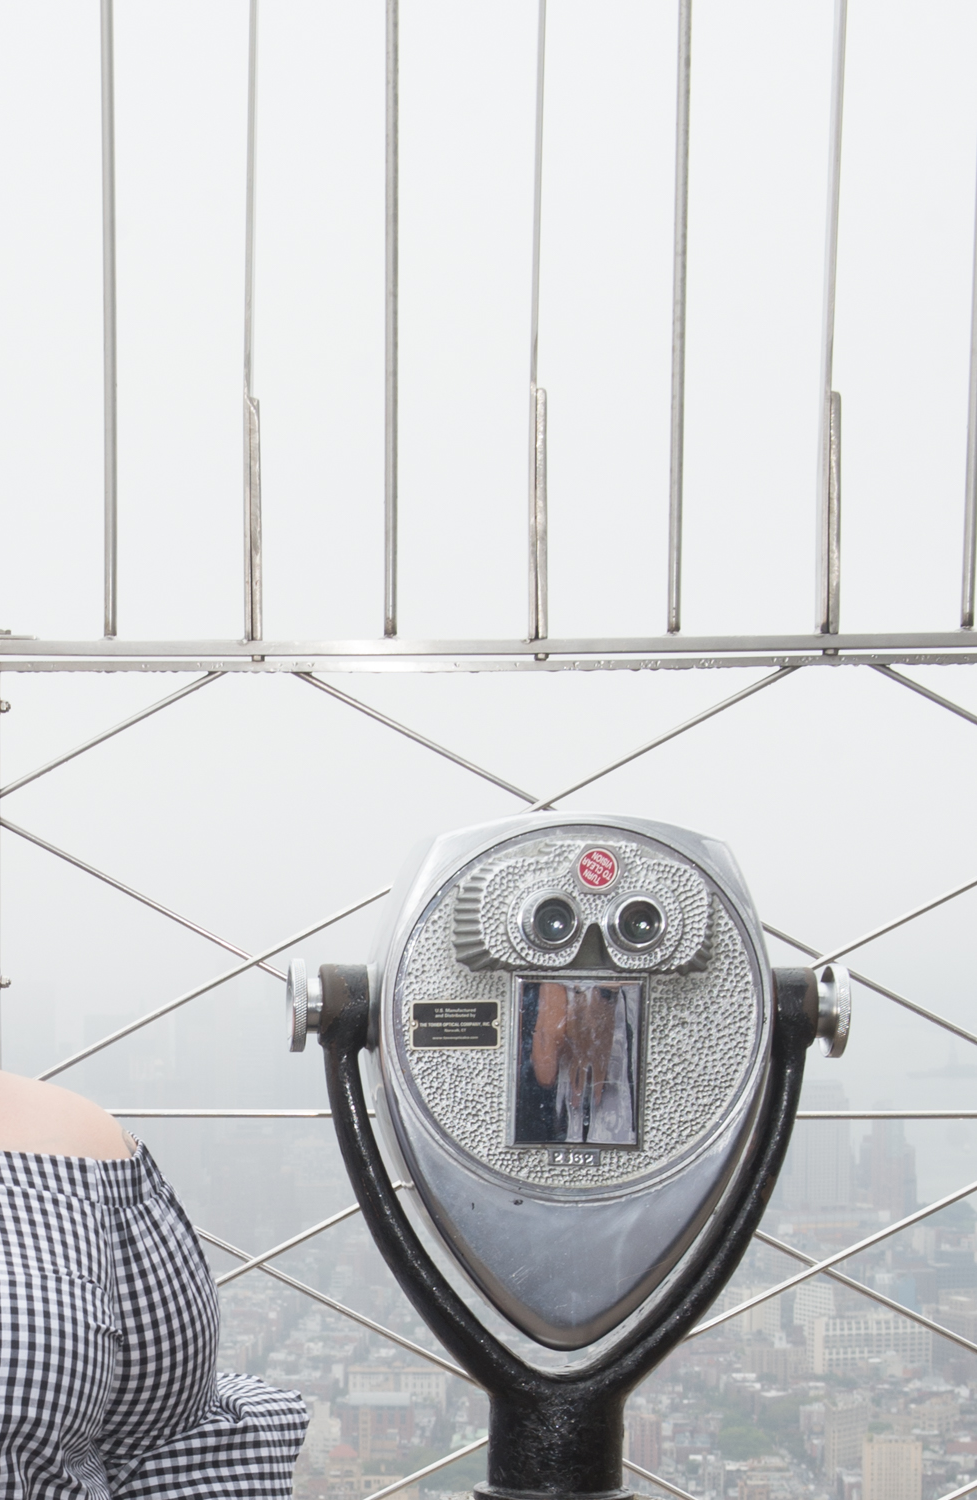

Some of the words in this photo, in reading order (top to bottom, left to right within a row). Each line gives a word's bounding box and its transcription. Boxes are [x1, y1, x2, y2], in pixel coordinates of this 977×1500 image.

[581, 857, 604, 874] CLEAR
[591, 852, 612, 870] VISION
[582, 869, 601, 884] TURN
[602, 870, 612, 880] TO
